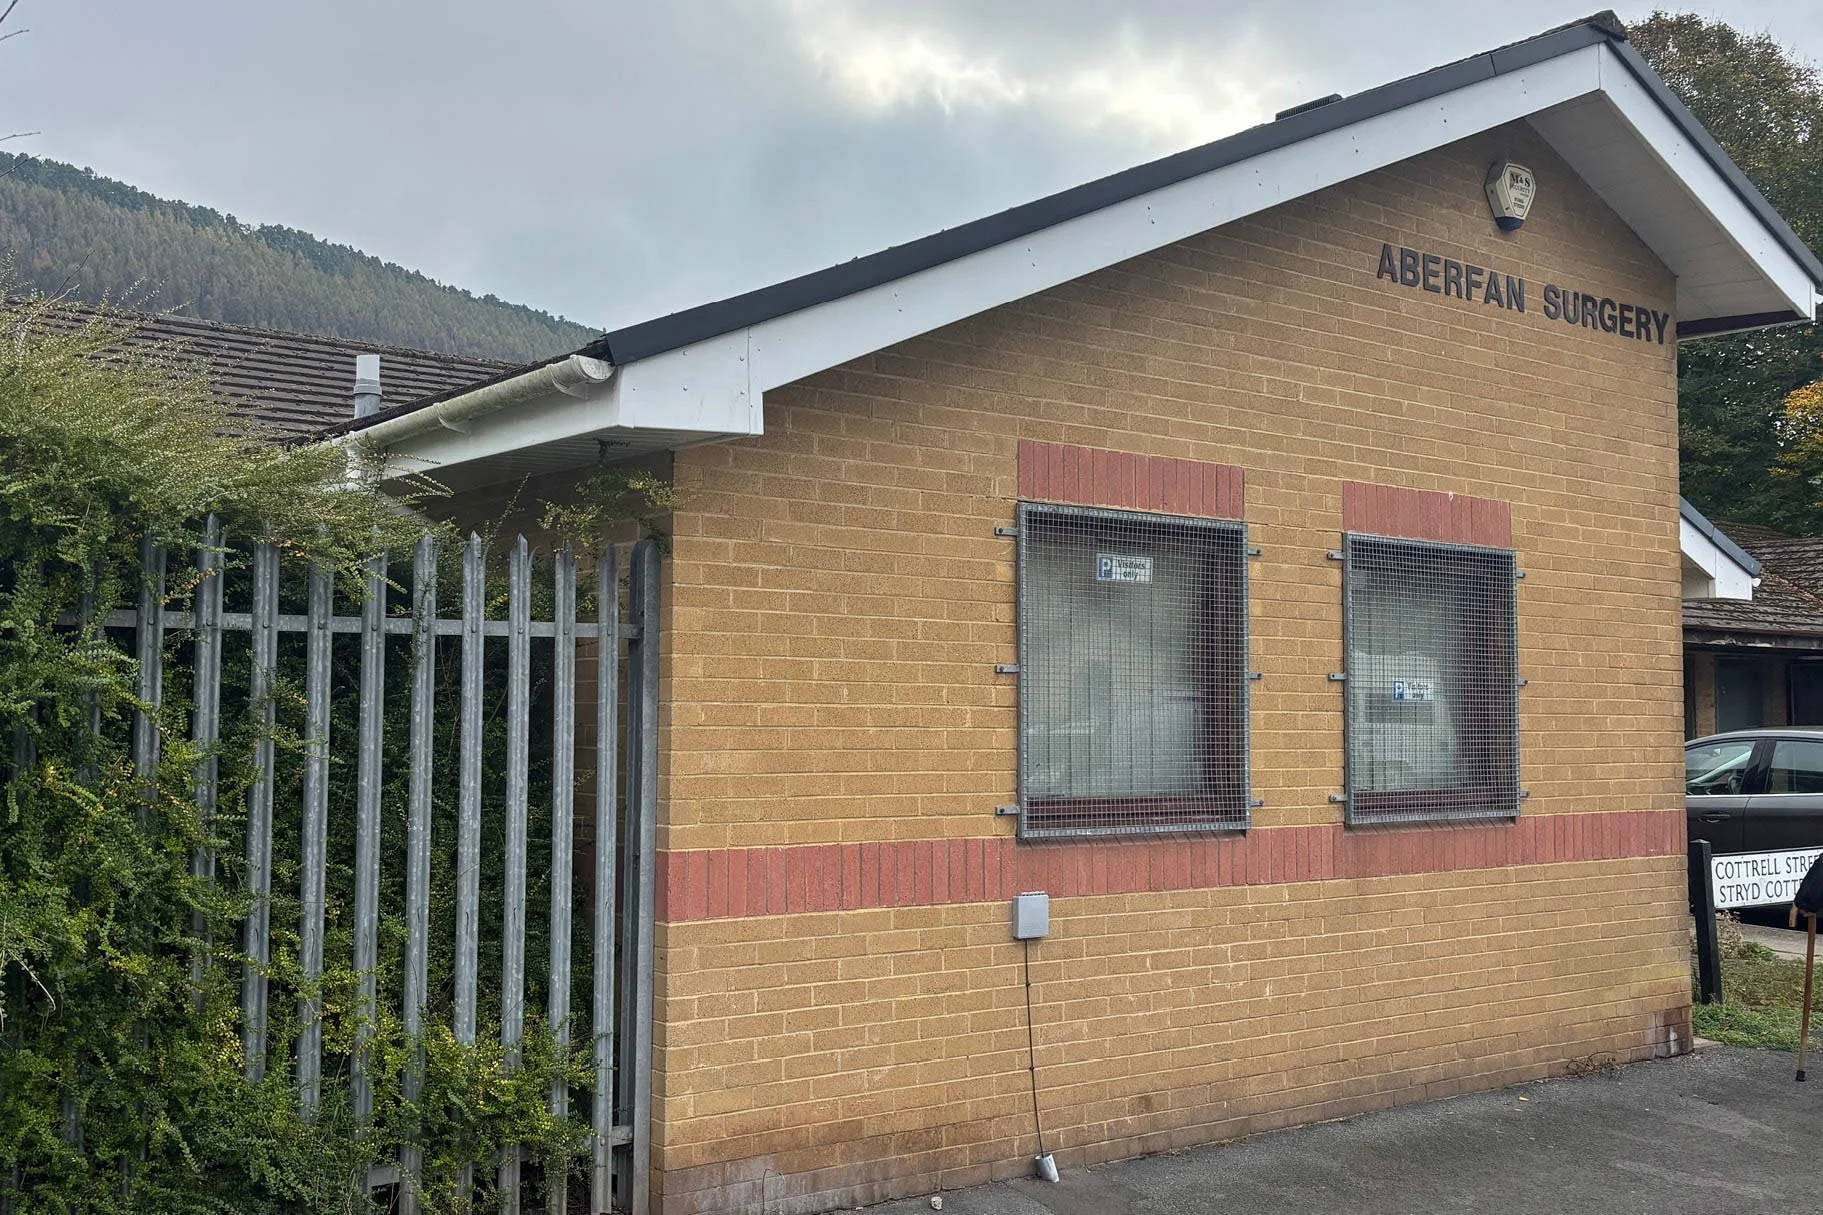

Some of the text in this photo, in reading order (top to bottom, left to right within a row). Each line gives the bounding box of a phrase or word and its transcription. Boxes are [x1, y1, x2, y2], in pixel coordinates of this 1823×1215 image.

[1377, 243, 1669, 345] ABERFAN SURGERY
[1101, 558, 1112, 578] P
[1117, 560, 1146, 570] Visitors
[1123, 570, 1139, 581] only
[1395, 681, 1403, 700] P
[1715, 854, 1820, 880] COTTRELL STRE
[1719, 878, 1804, 903] STRYD COTT
